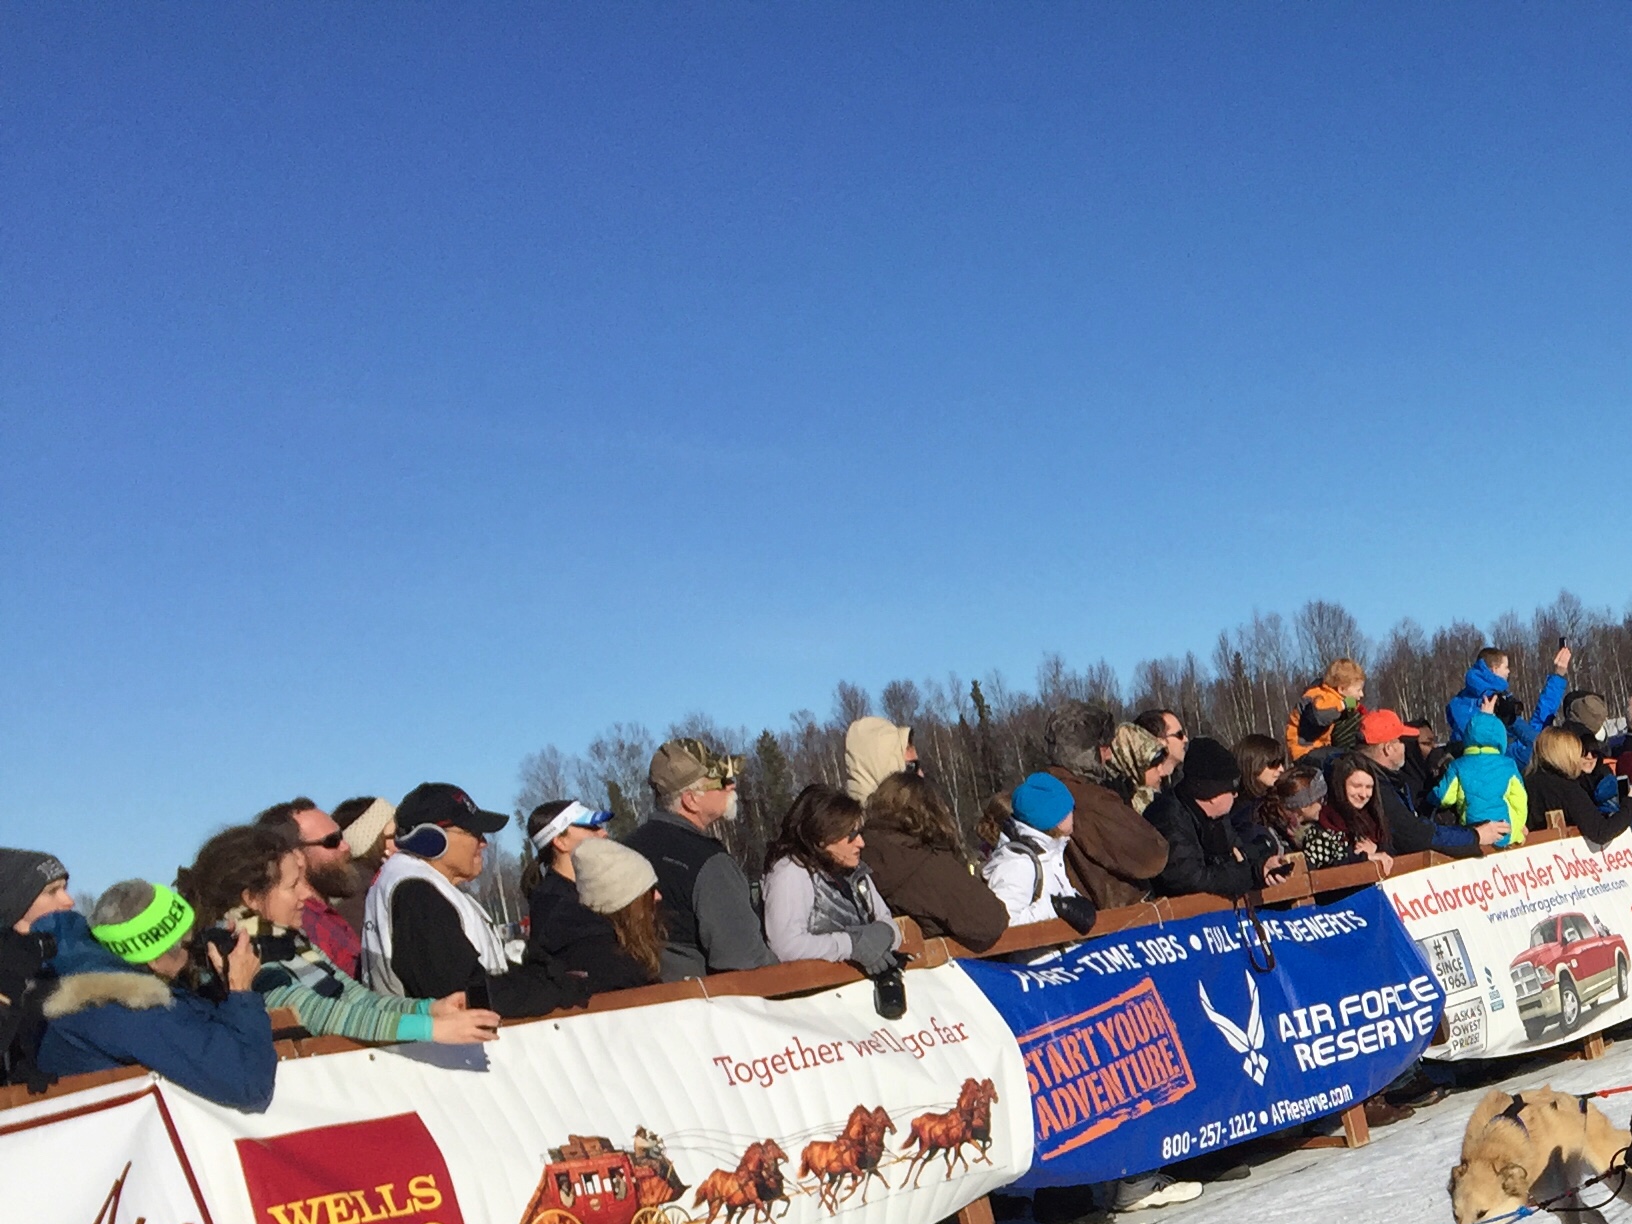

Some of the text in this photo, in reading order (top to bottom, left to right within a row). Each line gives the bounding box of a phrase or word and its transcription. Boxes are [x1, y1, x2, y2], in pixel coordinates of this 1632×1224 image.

[1392, 879, 1494, 924] Anchorage
[1491, 856, 1555, 901] Chrysler
[1553, 848, 1603, 883] Dodge
[1011, 943, 1143, 993] PART-TIME
[1136, 934, 1188, 966] JOBS
[1283, 909, 1368, 942] BENEFITS
[1432, 935, 1454, 960] #1
[1435, 957, 1464, 977] SINCE
[1442, 972, 1467, 991] 1963
[1278, 974, 1440, 1043] AIR FORCE
[1293, 1004, 1434, 1073] RESERVE
[1447, 1004, 1483, 1025] LASKA'S
[1451, 1018, 1480, 1038] OWEST
[712, 1016, 969, 1088] Together we'll go far
[1022, 1000, 1165, 1096] START YOUR
[1035, 1037, 1181, 1141] ADVENTURE
[1161, 1083, 1354, 1160] 800-257-1212 AFReserve.com
